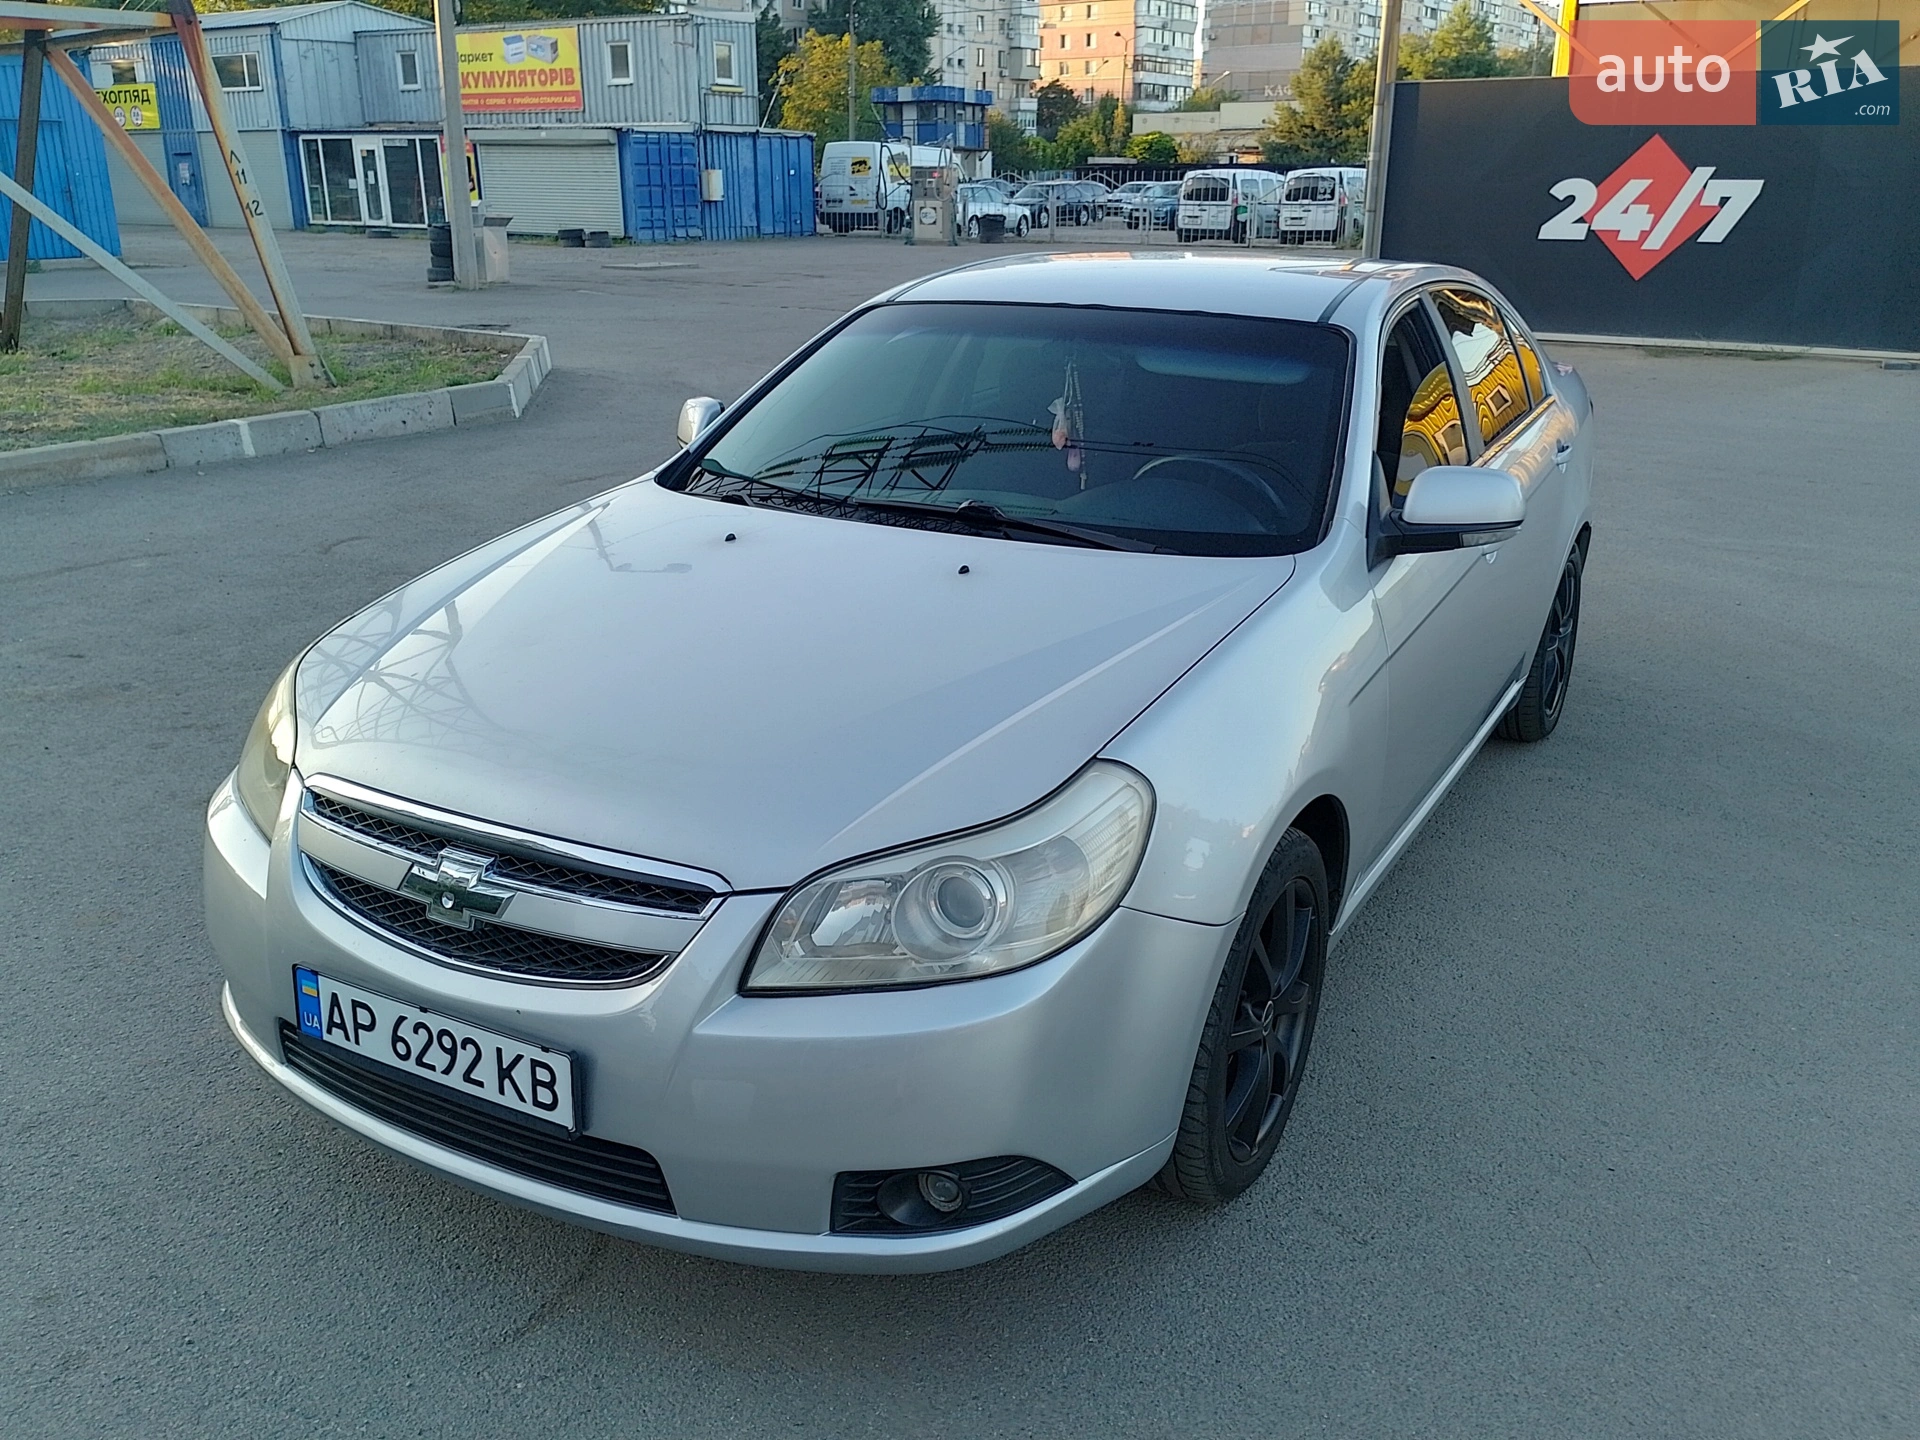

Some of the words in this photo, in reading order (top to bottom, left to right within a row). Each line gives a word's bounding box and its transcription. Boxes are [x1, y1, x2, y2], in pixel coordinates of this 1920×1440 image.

[460, 67, 576, 89] КУМУЛЯТОРІВ
[235, 168, 248, 185] 11
[245, 199, 264, 218] 12
[1537, 167, 1765, 250] 24/7
[304, 1011, 321, 1031] UA
[326, 991, 377, 1046] AP
[391, 1014, 485, 1089] 6292
[496, 1046, 559, 1112] KB
